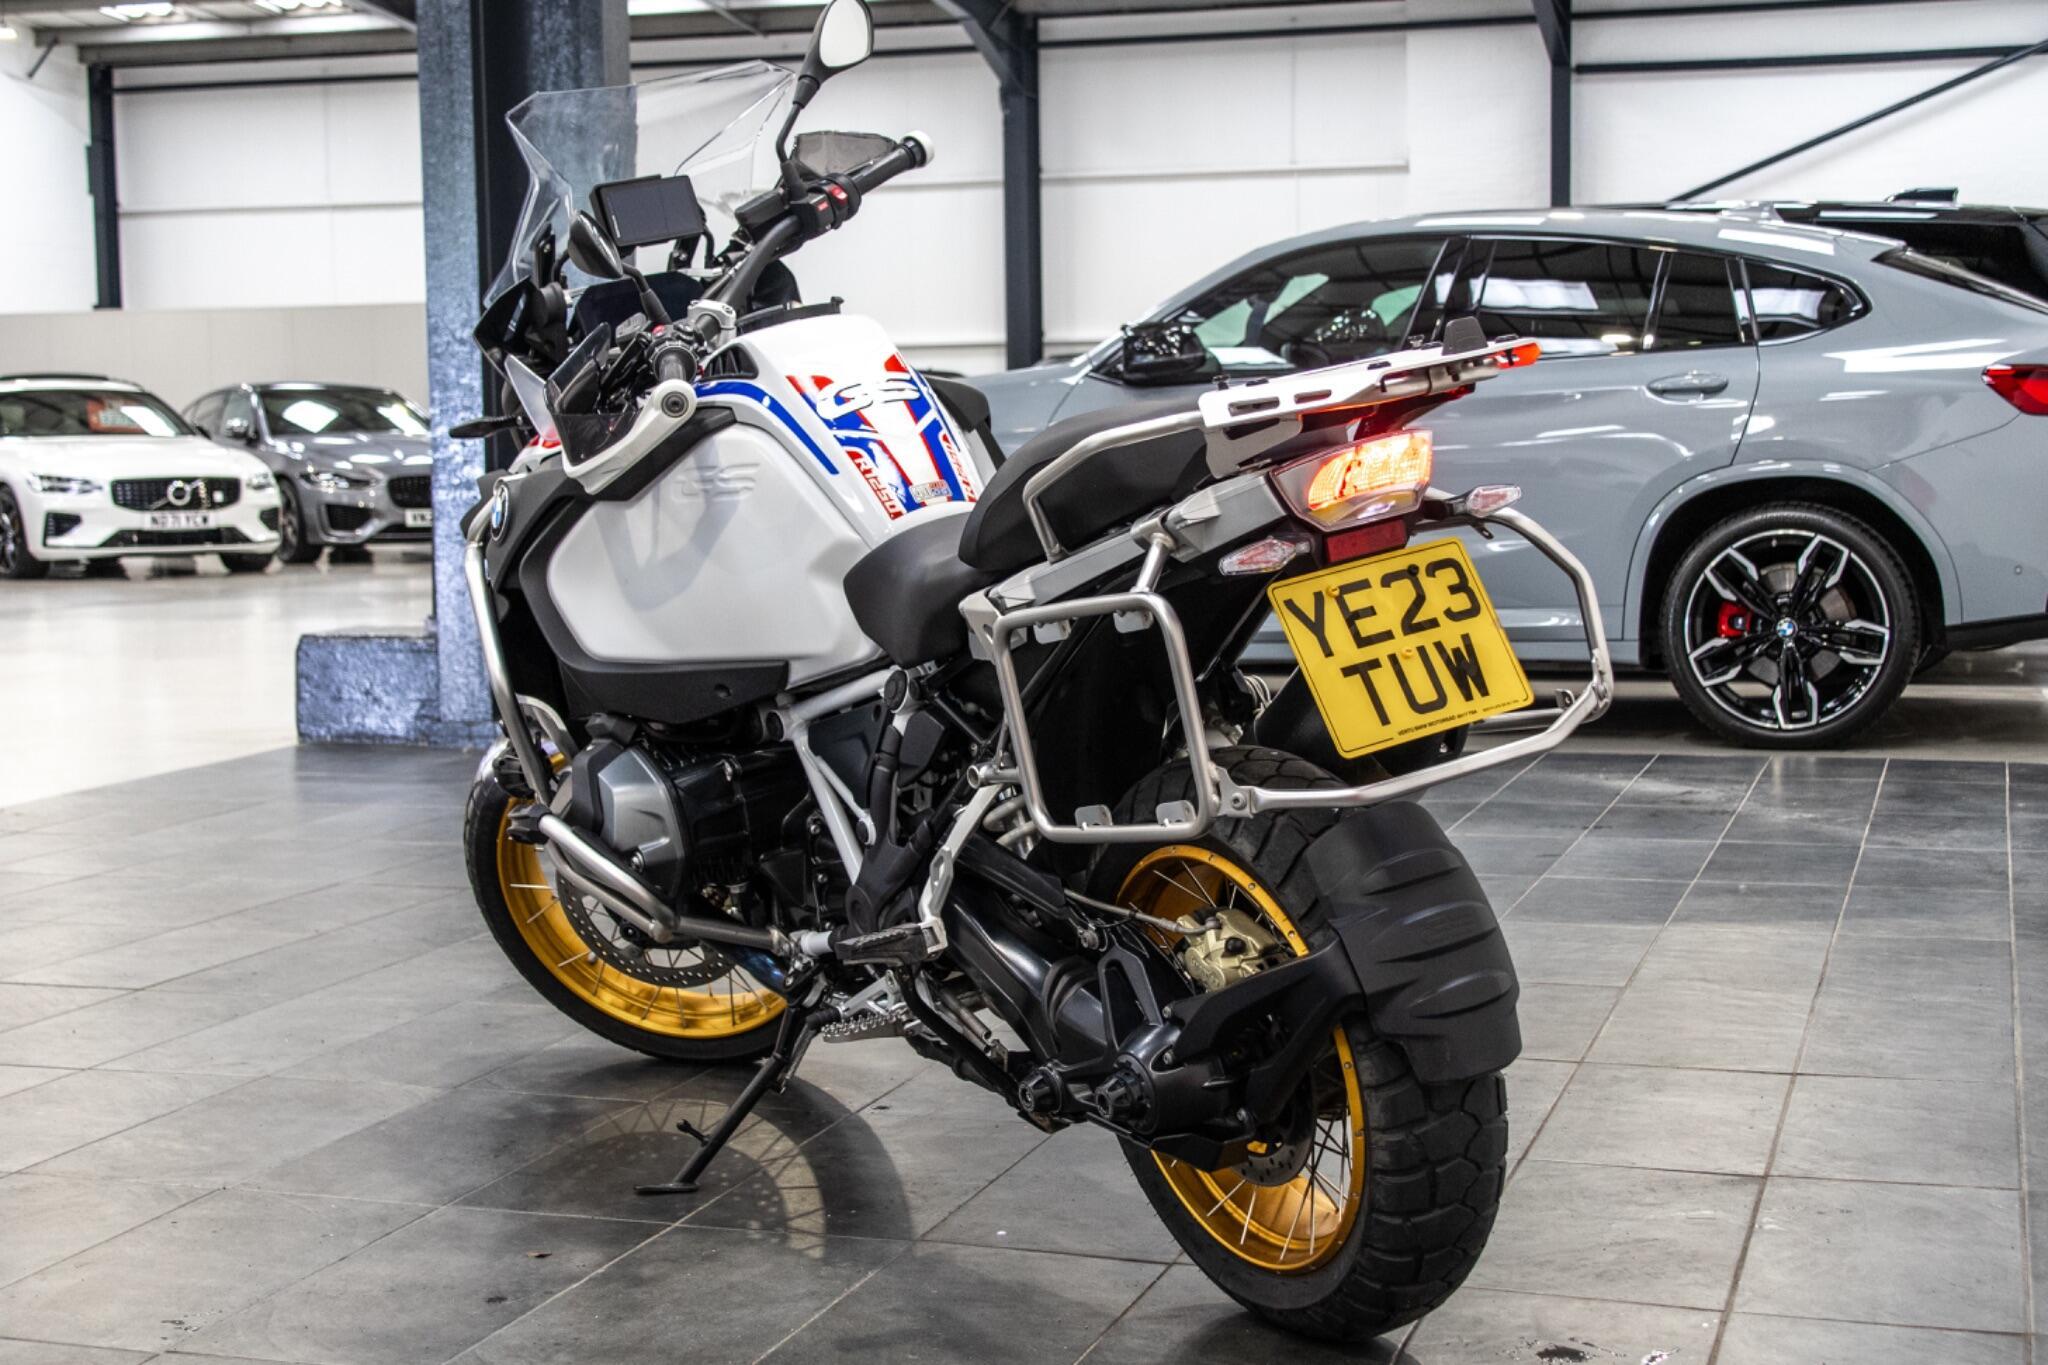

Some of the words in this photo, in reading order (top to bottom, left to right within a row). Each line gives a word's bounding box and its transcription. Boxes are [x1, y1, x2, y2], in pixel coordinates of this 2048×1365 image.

[853, 456, 902, 515] R1250
[1283, 558, 1481, 658] YE23
[1340, 633, 1490, 726] TUW
